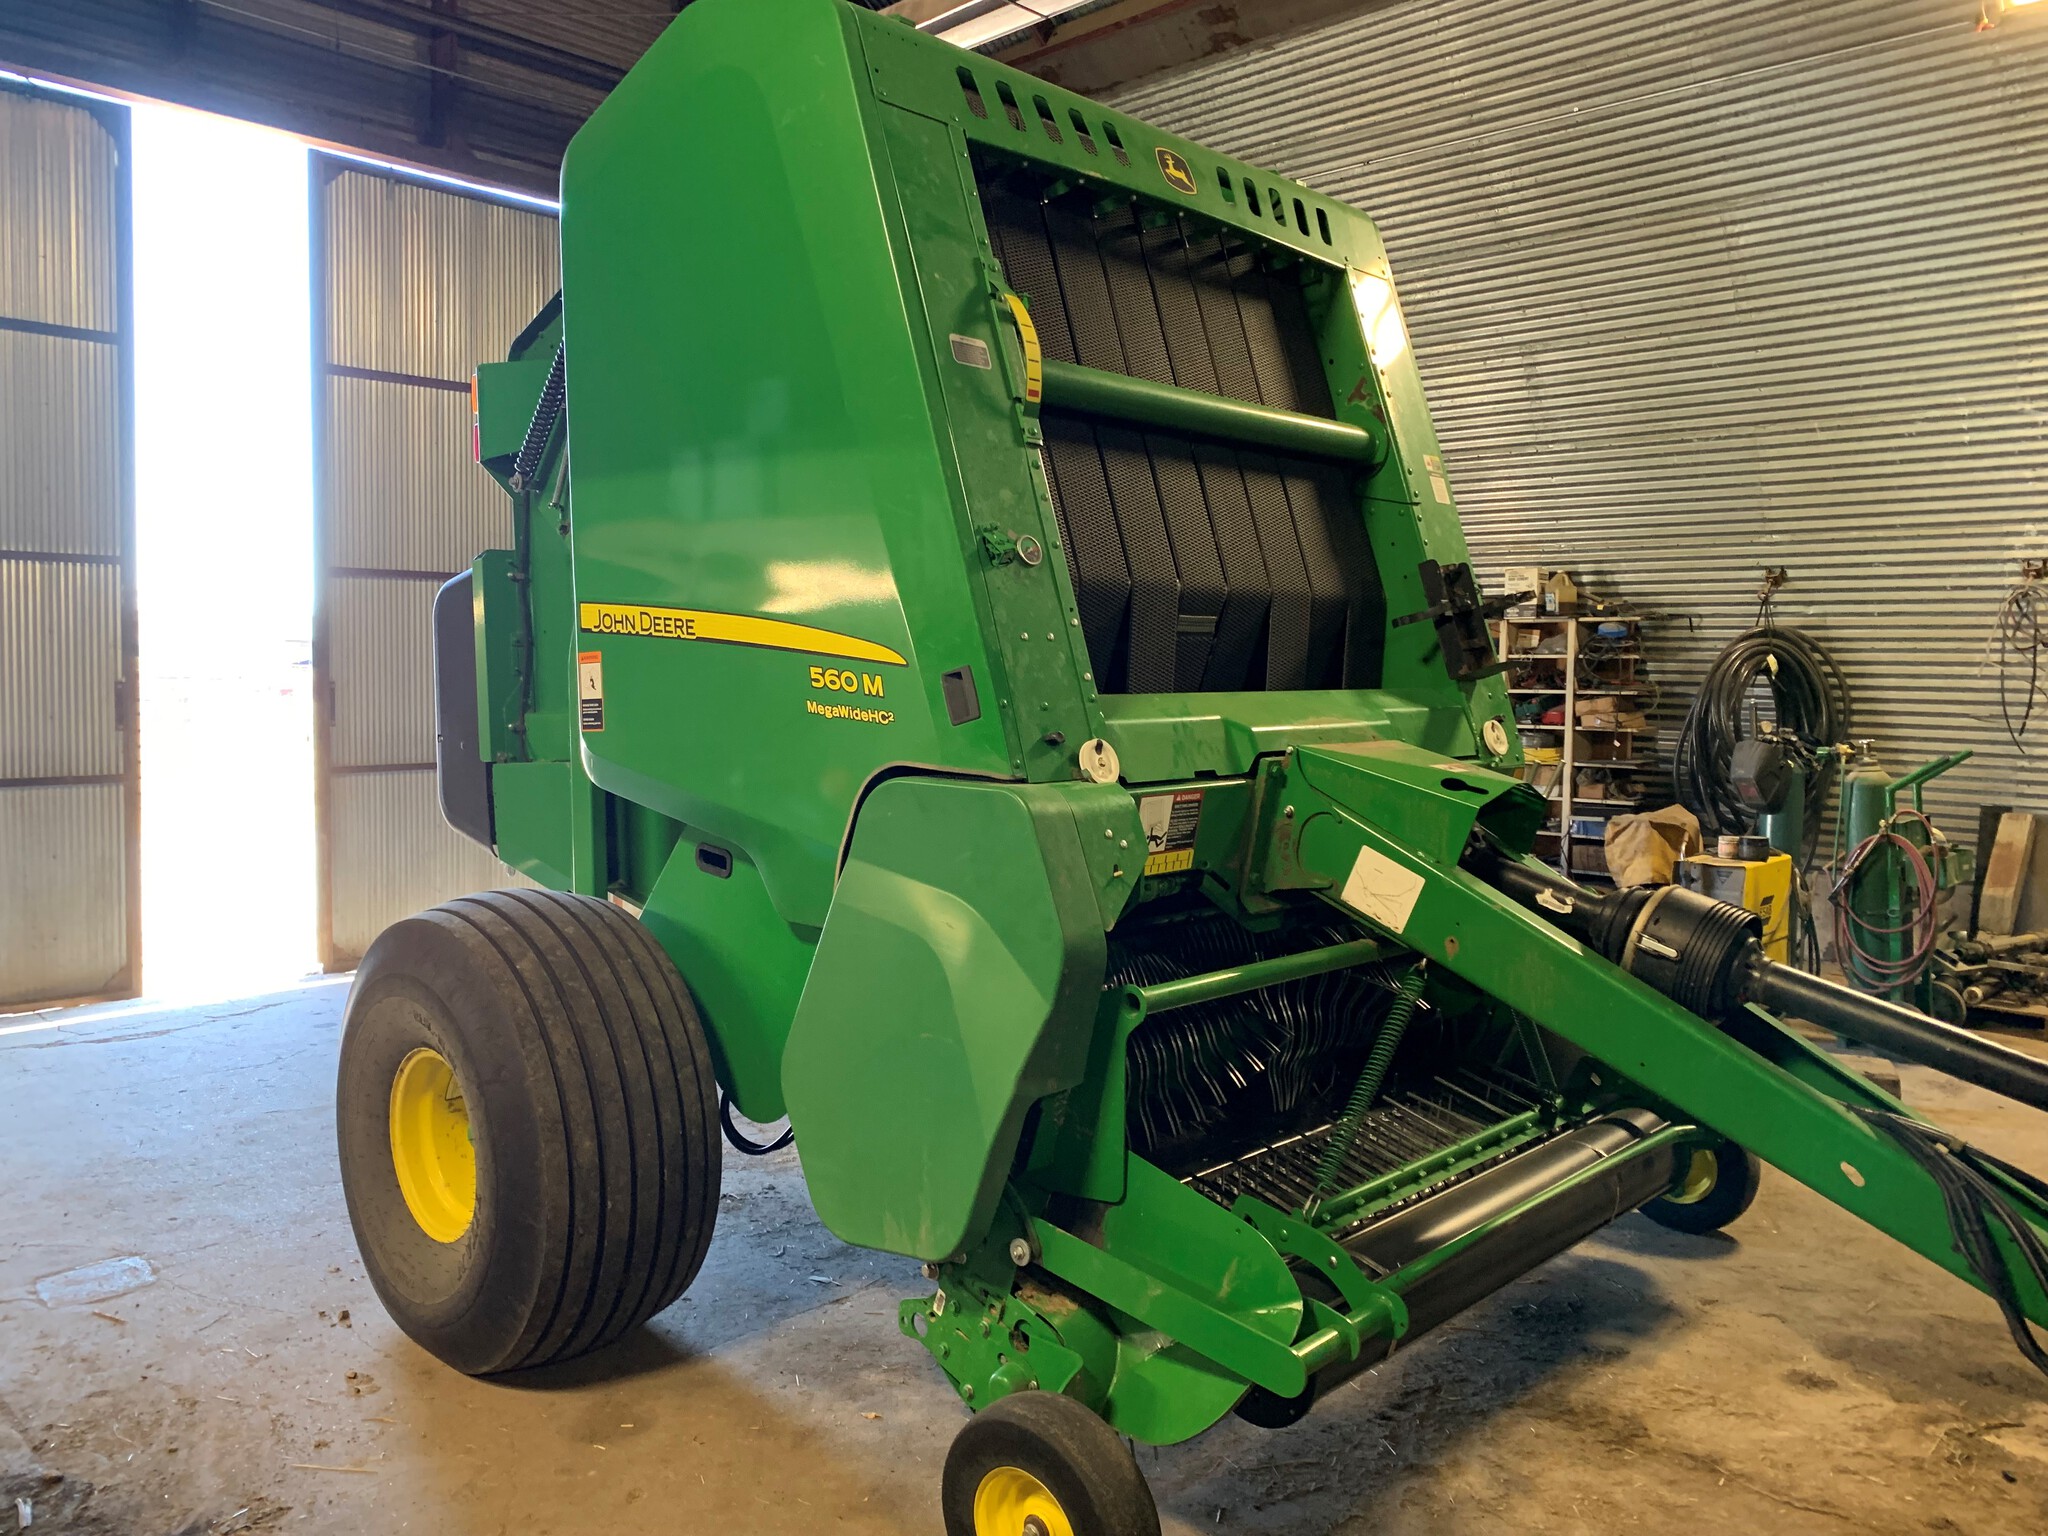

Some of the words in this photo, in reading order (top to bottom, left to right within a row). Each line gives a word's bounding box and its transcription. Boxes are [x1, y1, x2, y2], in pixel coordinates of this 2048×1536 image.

[593, 609, 636, 631] JOHN
[639, 611, 696, 636] DEERE
[810, 666, 858, 693] 560
[862, 674, 884, 696] M
[1181, 793, 1201, 801] DANGER
